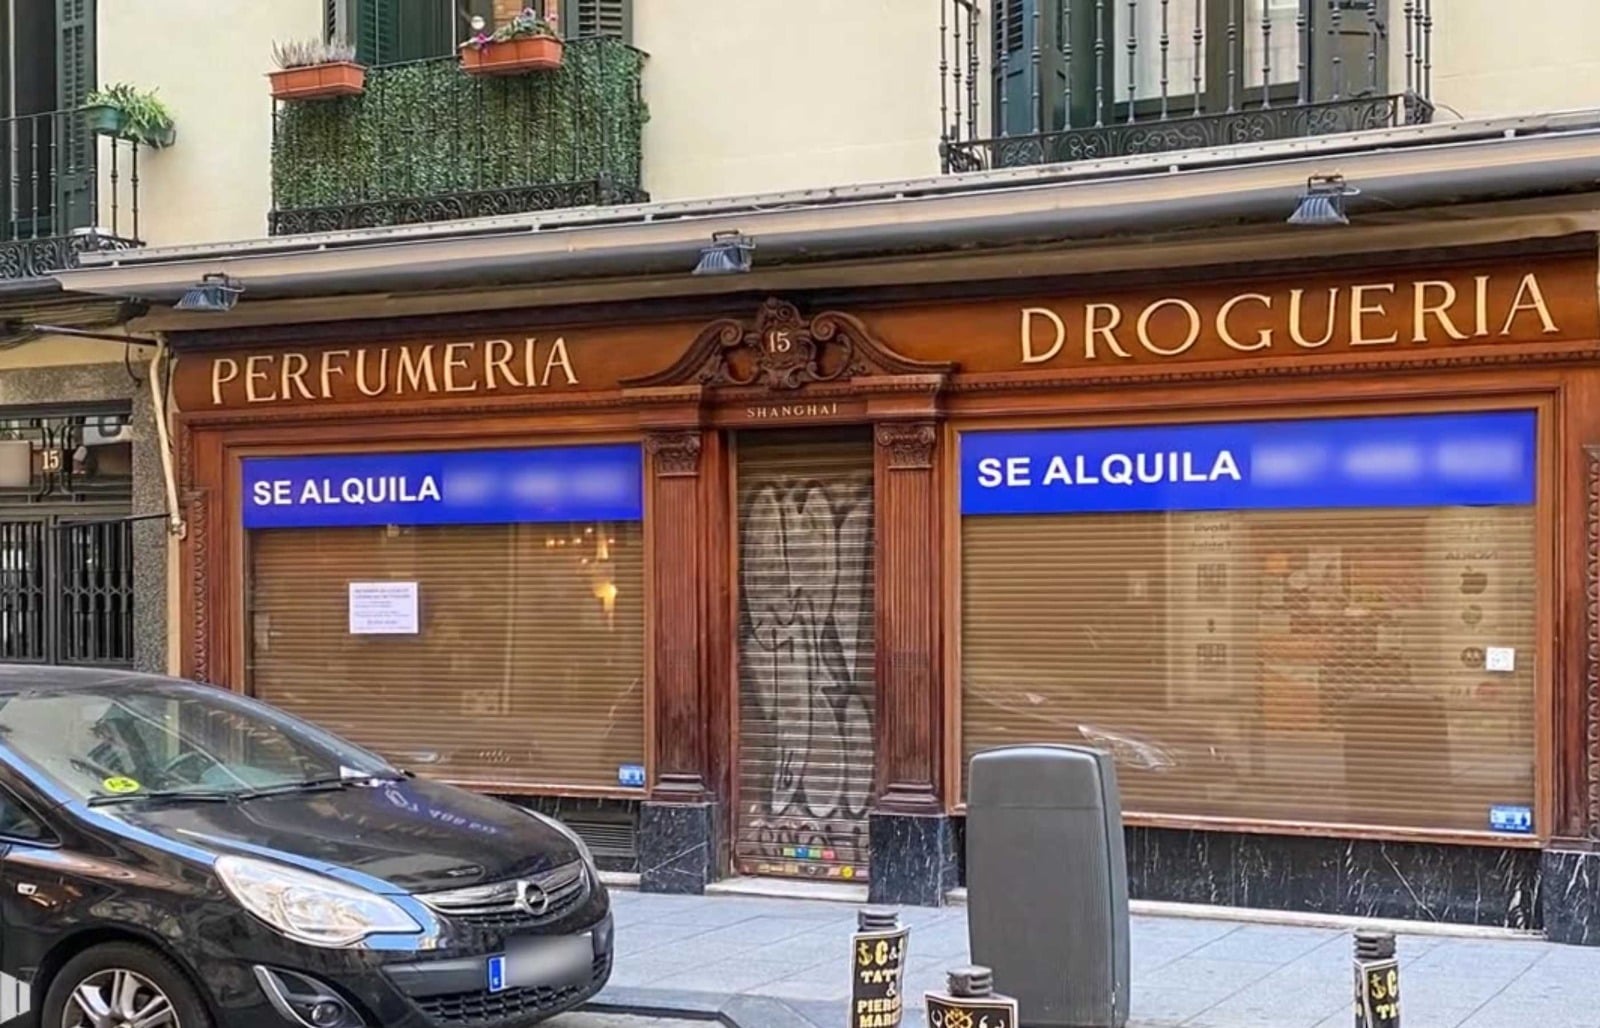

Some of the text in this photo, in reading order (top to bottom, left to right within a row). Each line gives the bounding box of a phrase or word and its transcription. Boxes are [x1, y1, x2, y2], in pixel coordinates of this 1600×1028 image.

[1020, 272, 1560, 364] DROGUERIA
[769, 331, 792, 353] 15
[211, 336, 580, 405] PERFUMERIA
[746, 402, 838, 418] SHANGHAI
[42, 450, 60, 470] 15
[977, 456, 1032, 488] SE
[1041, 450, 1242, 486] ALQUILA
[252, 479, 292, 506] SE
[299, 475, 441, 505] ALQUILA
